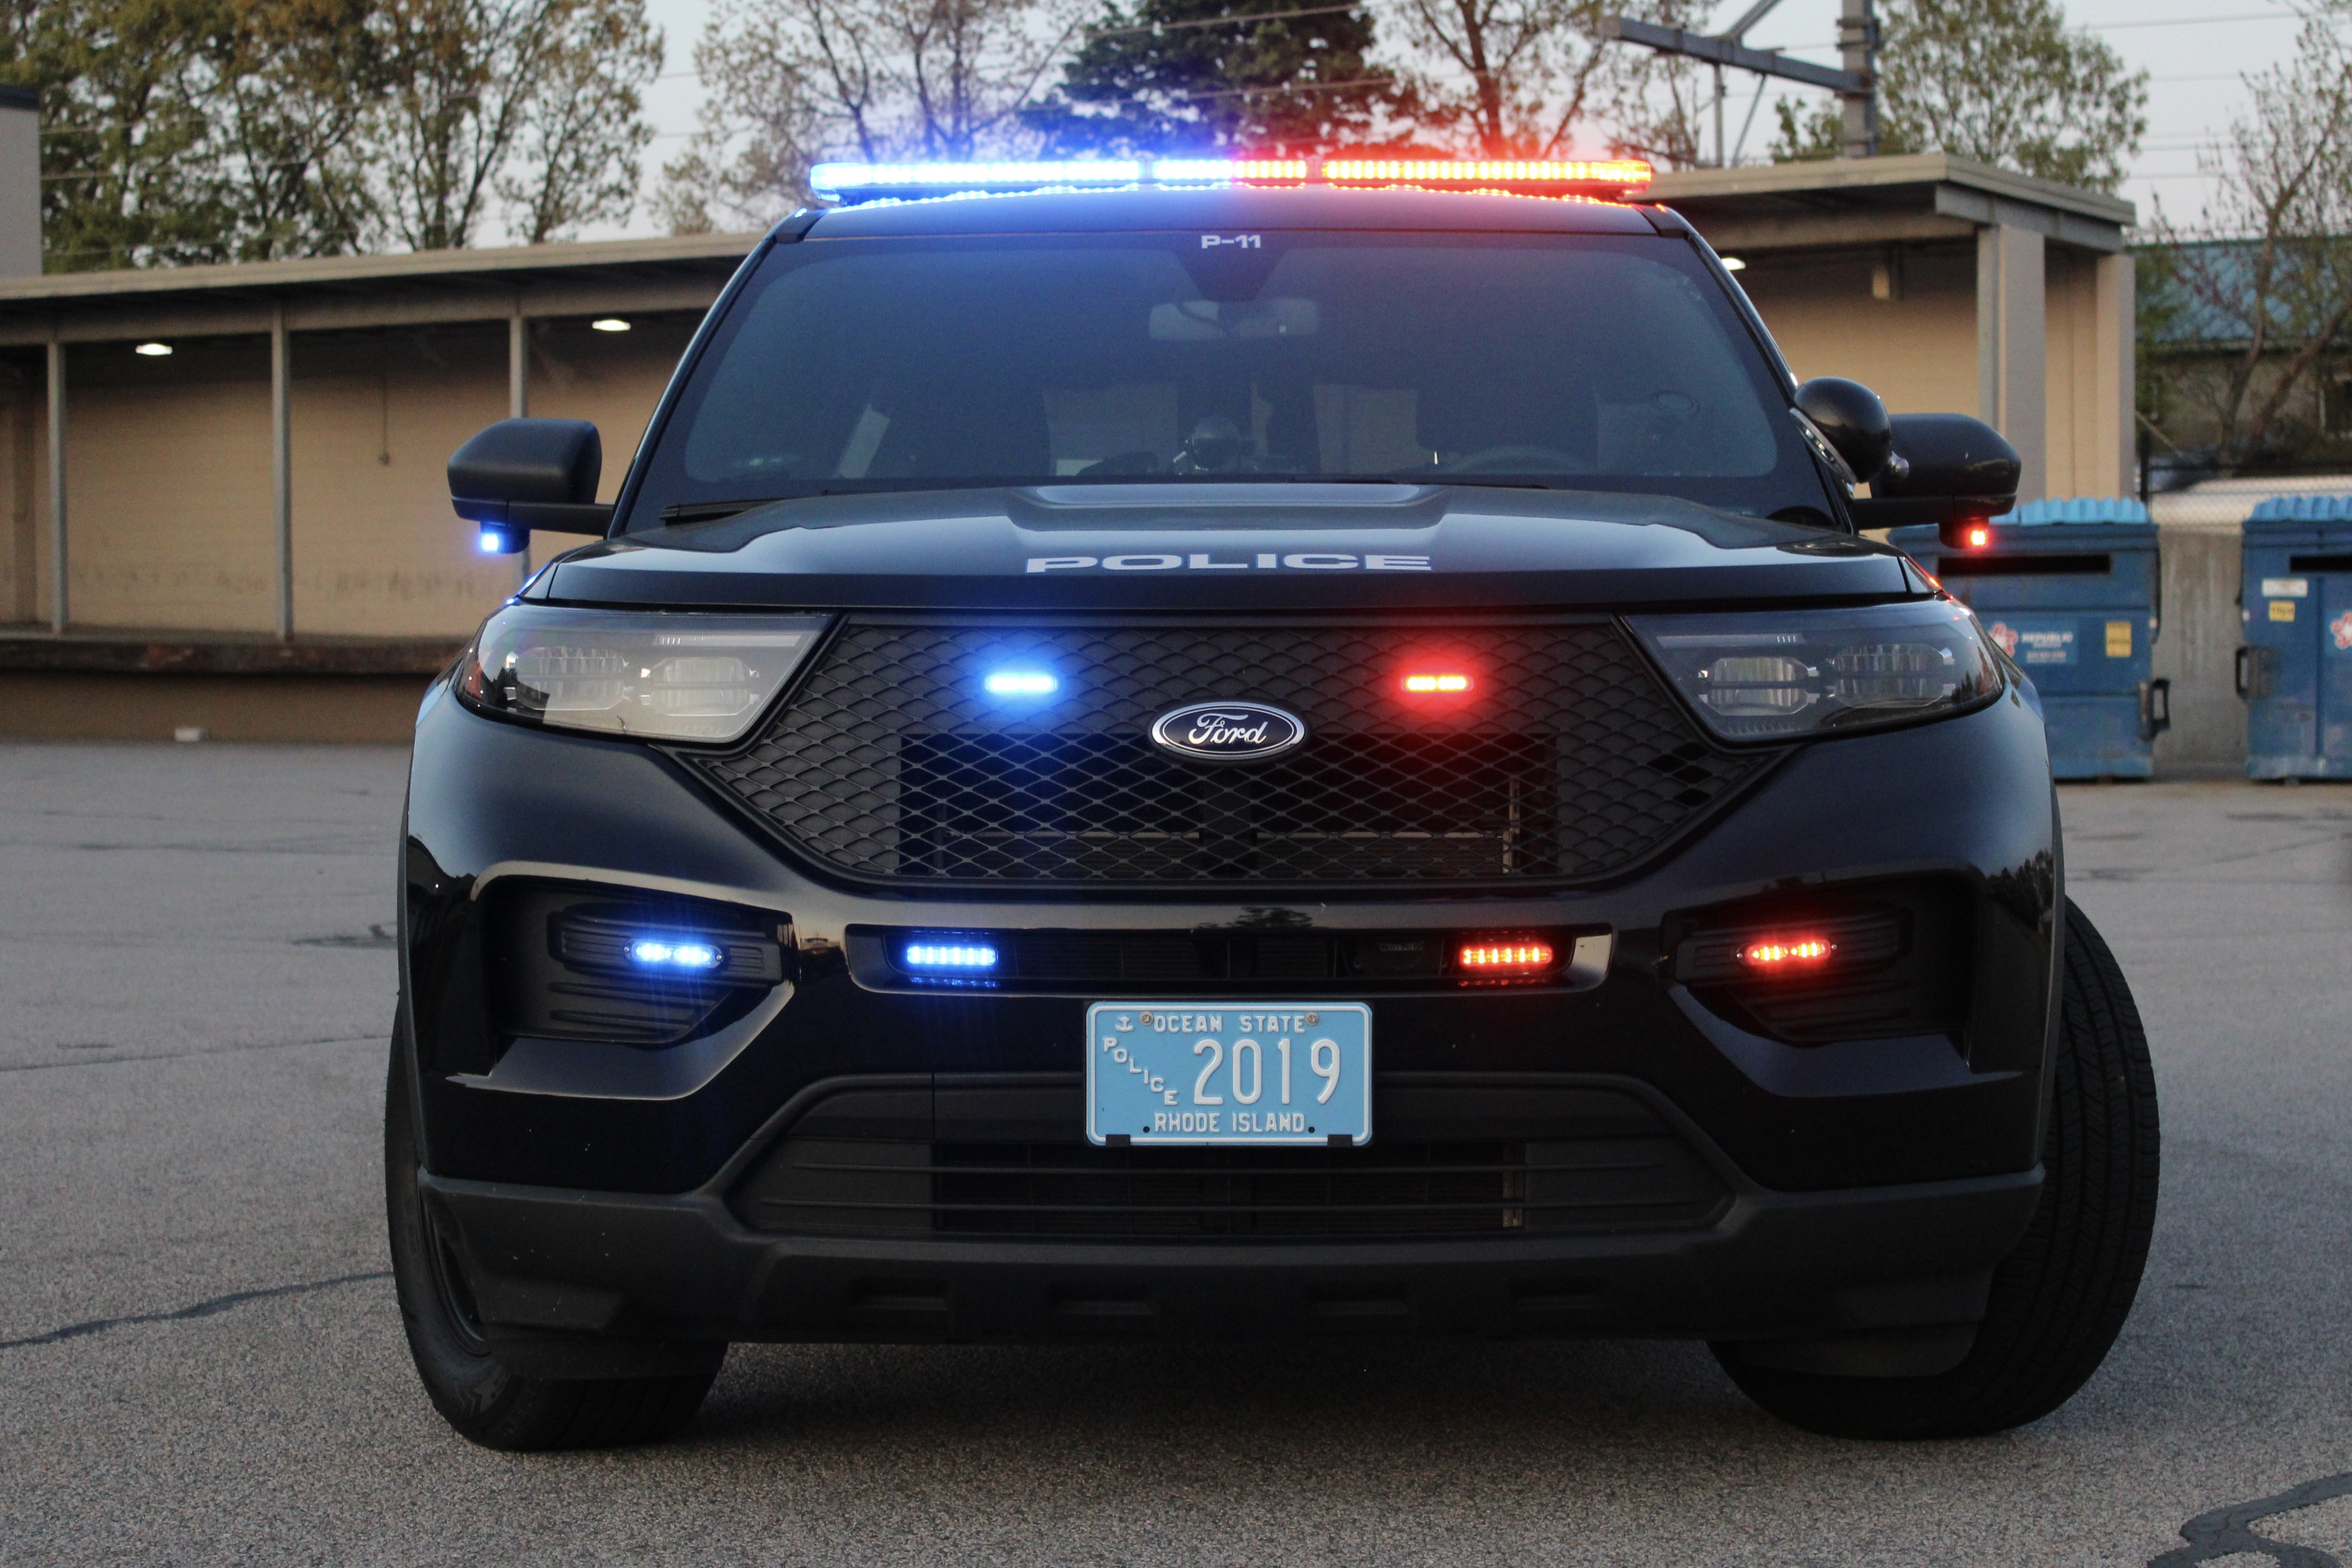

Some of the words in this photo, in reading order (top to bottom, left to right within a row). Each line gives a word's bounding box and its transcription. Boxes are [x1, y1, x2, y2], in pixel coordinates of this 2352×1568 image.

[1201, 234, 1261, 249] P-11
[1026, 554, 1432, 573] POLICE
[1189, 712, 1267, 745] Ford
[1154, 1016, 1223, 1033] OCEAN
[1240, 1016, 1305, 1033] STATE
[1103, 1038, 1178, 1105] POLICE
[1194, 1038, 1340, 1105] 2019
[1154, 1113, 1220, 1133] RHODE
[1232, 1113, 1305, 1133] ISLAND
